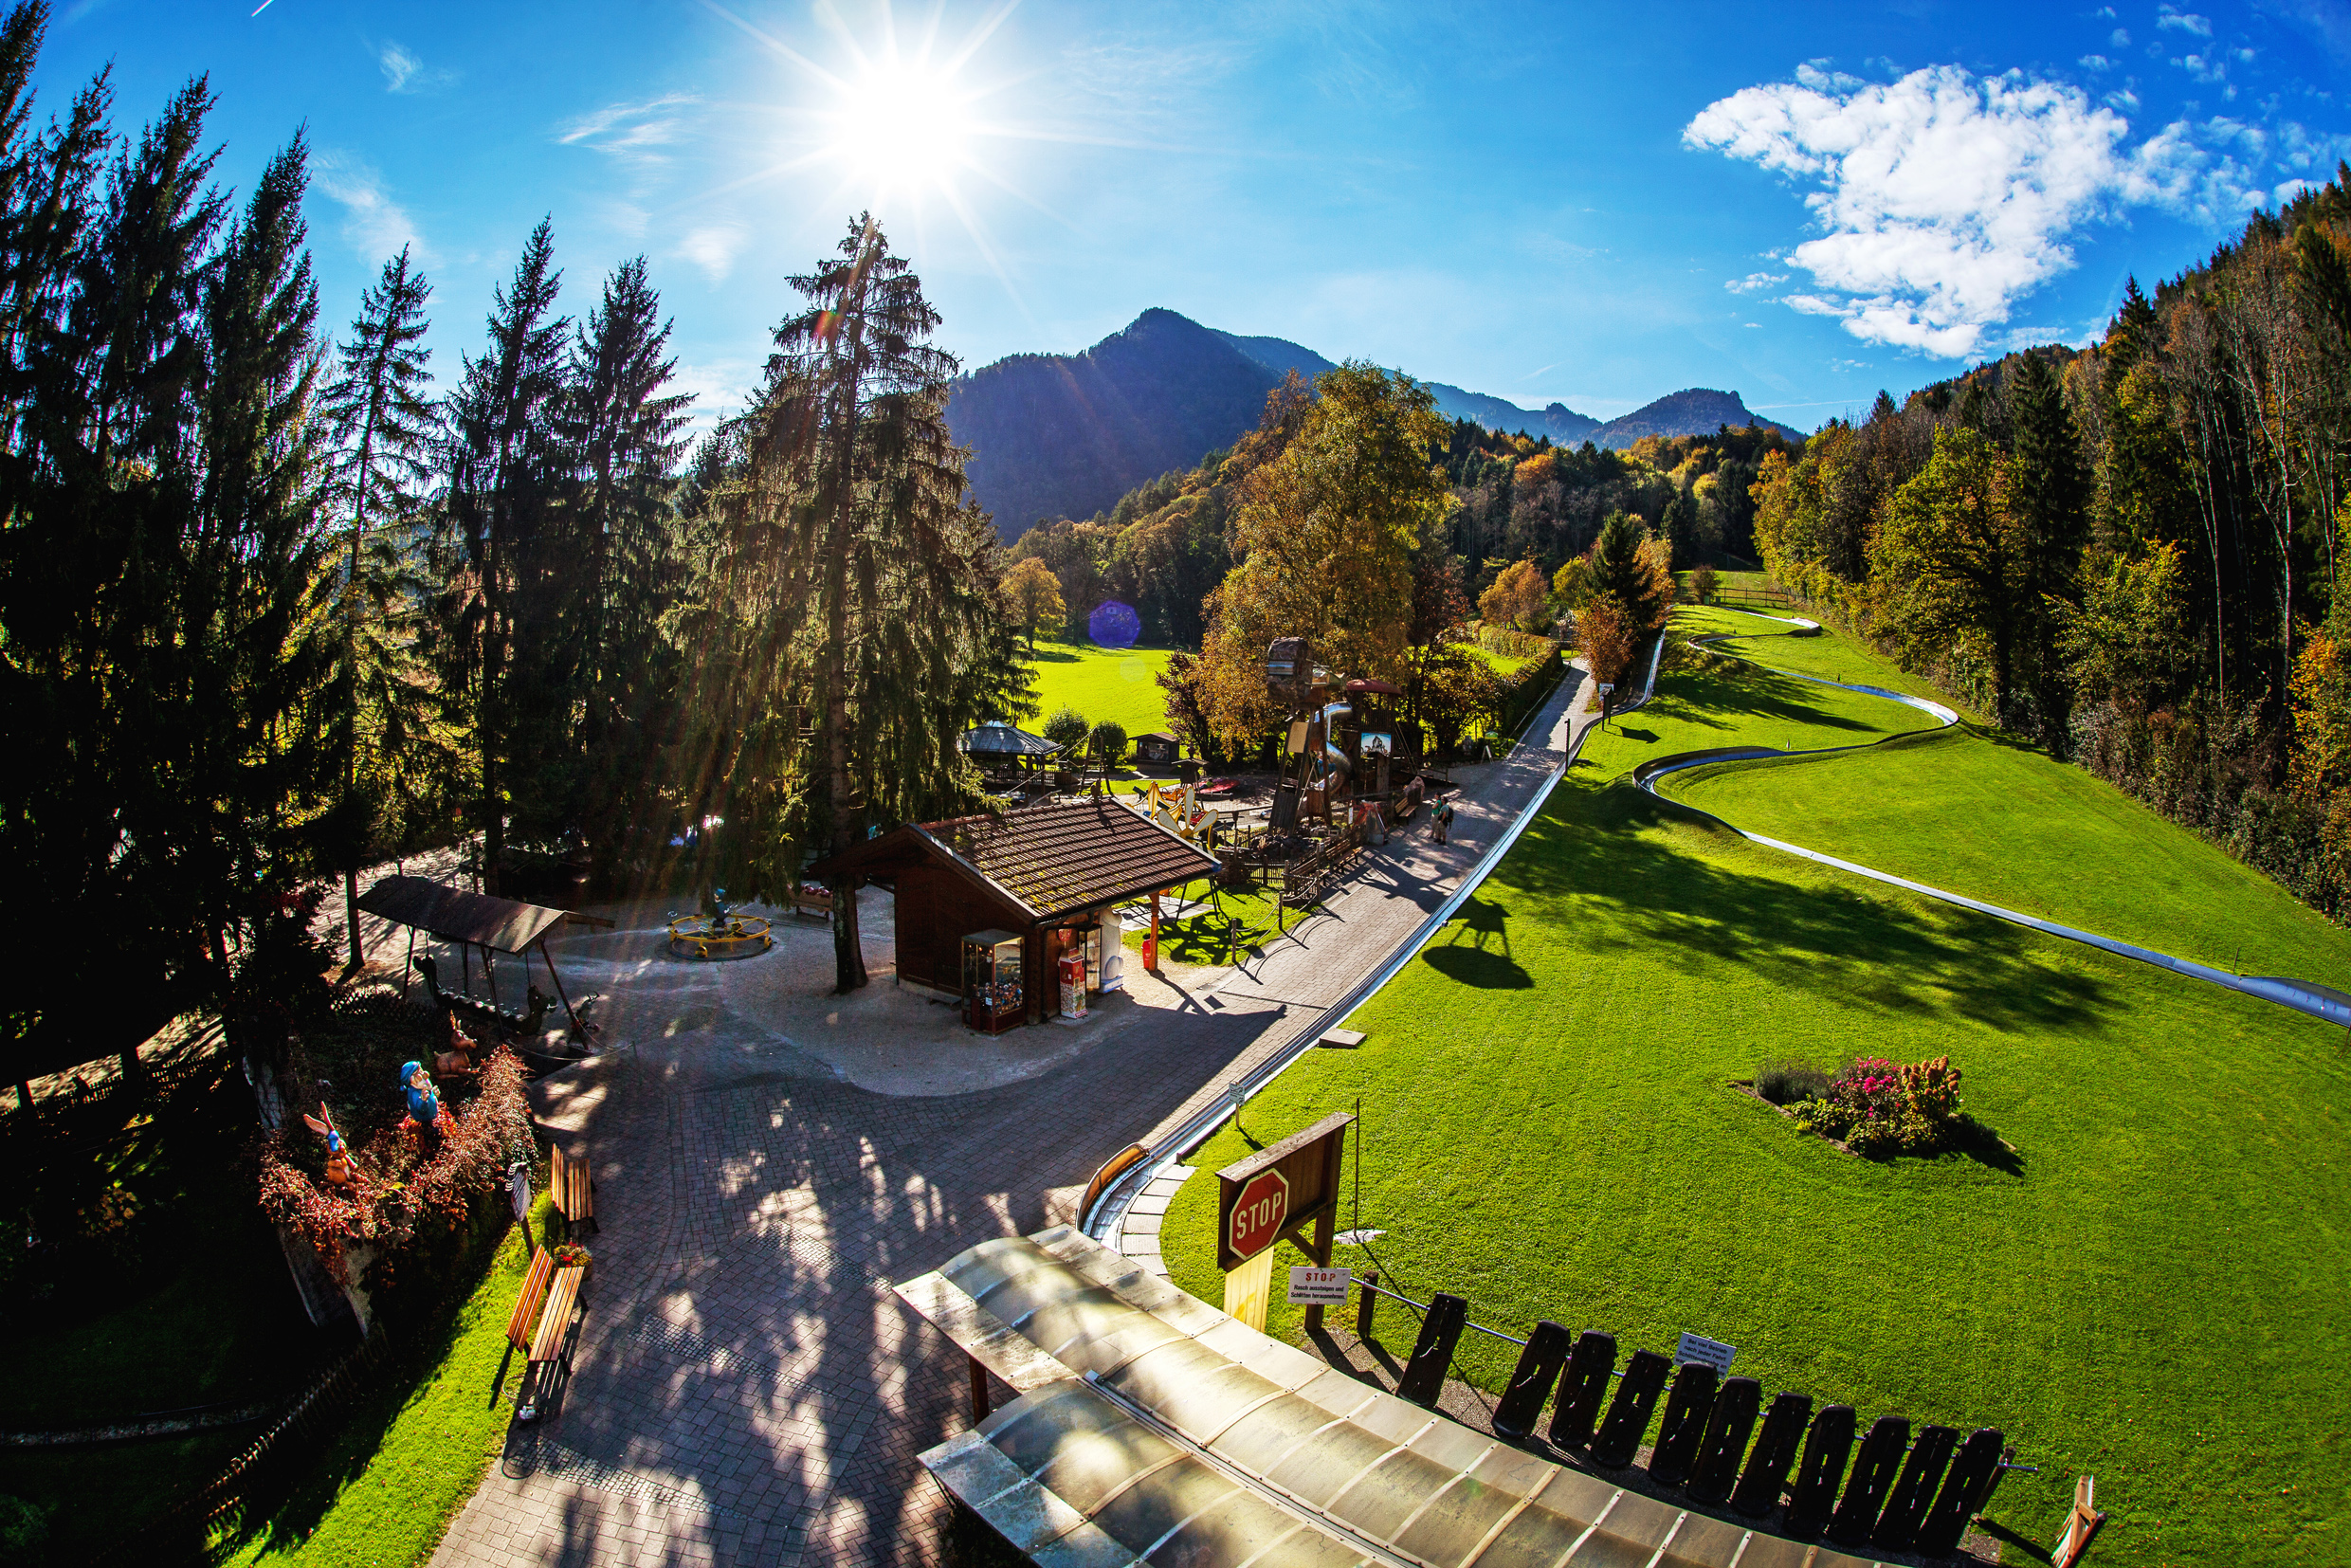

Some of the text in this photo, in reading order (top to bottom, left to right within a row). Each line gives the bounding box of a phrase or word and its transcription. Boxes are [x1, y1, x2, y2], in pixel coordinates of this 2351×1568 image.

[1237, 1192, 1282, 1239] STOP
[1305, 1272, 1336, 1282] STOP
[1708, 1343, 1727, 1354] Betrieb
[1712, 1353, 1726, 1361] Fahrt
